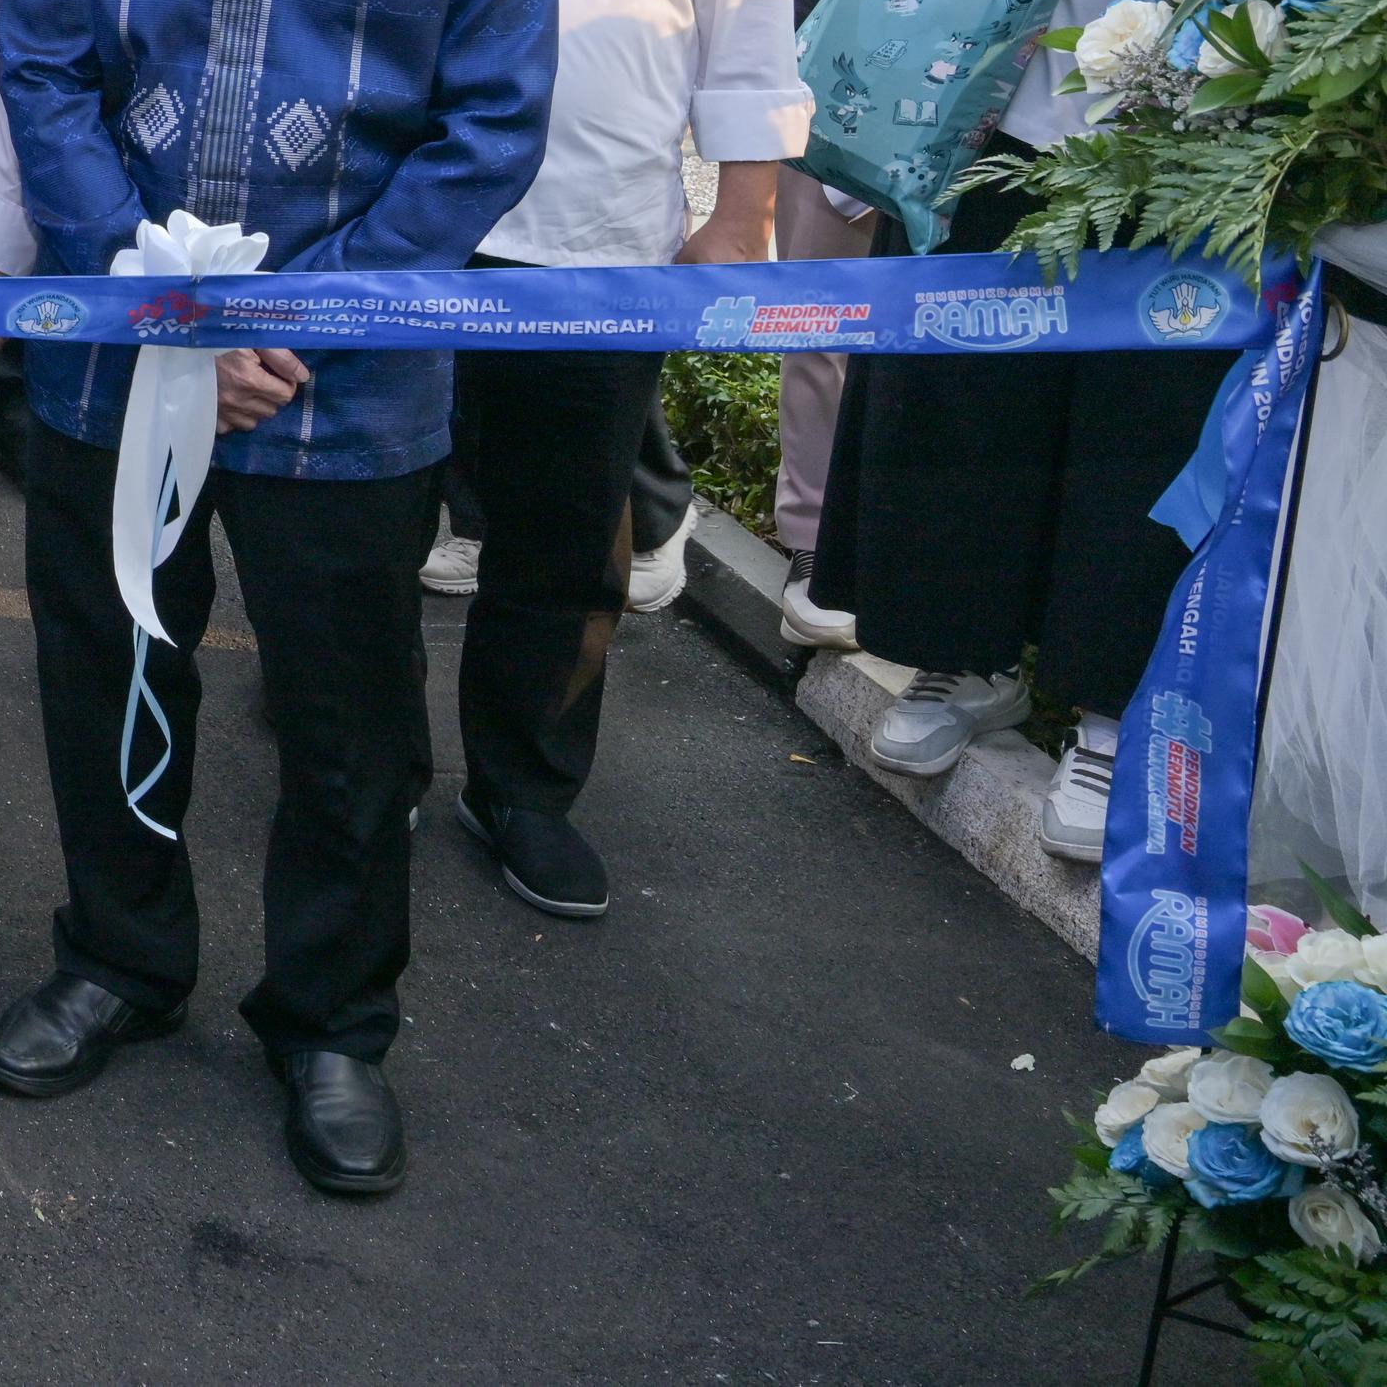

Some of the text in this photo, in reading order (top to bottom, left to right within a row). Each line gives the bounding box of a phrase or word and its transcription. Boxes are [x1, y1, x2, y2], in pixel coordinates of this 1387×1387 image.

[916, 287, 1064, 303] KEMENDIKDASMEN
[1149, 274, 1221, 299] TUT WURI HANDAYANI
[226, 297, 510, 314] KONSOLIDASI NASIONAL
[756, 306, 868, 320] PENDIDIKAN
[222, 309, 654, 334] PENDIDIKAN DASAR DAN MENENGAH
[750, 320, 838, 333] BERMUTU
[914, 297, 1067, 339] RAMAH
[221, 323, 366, 337] TAHUN 2025
[811, 331, 874, 345] SEMUA
[1167, 740, 1183, 823] BERMUTU
[1181, 750, 1201, 856] PENDIDIKAN
[1146, 889, 1195, 1029] RAMAH
